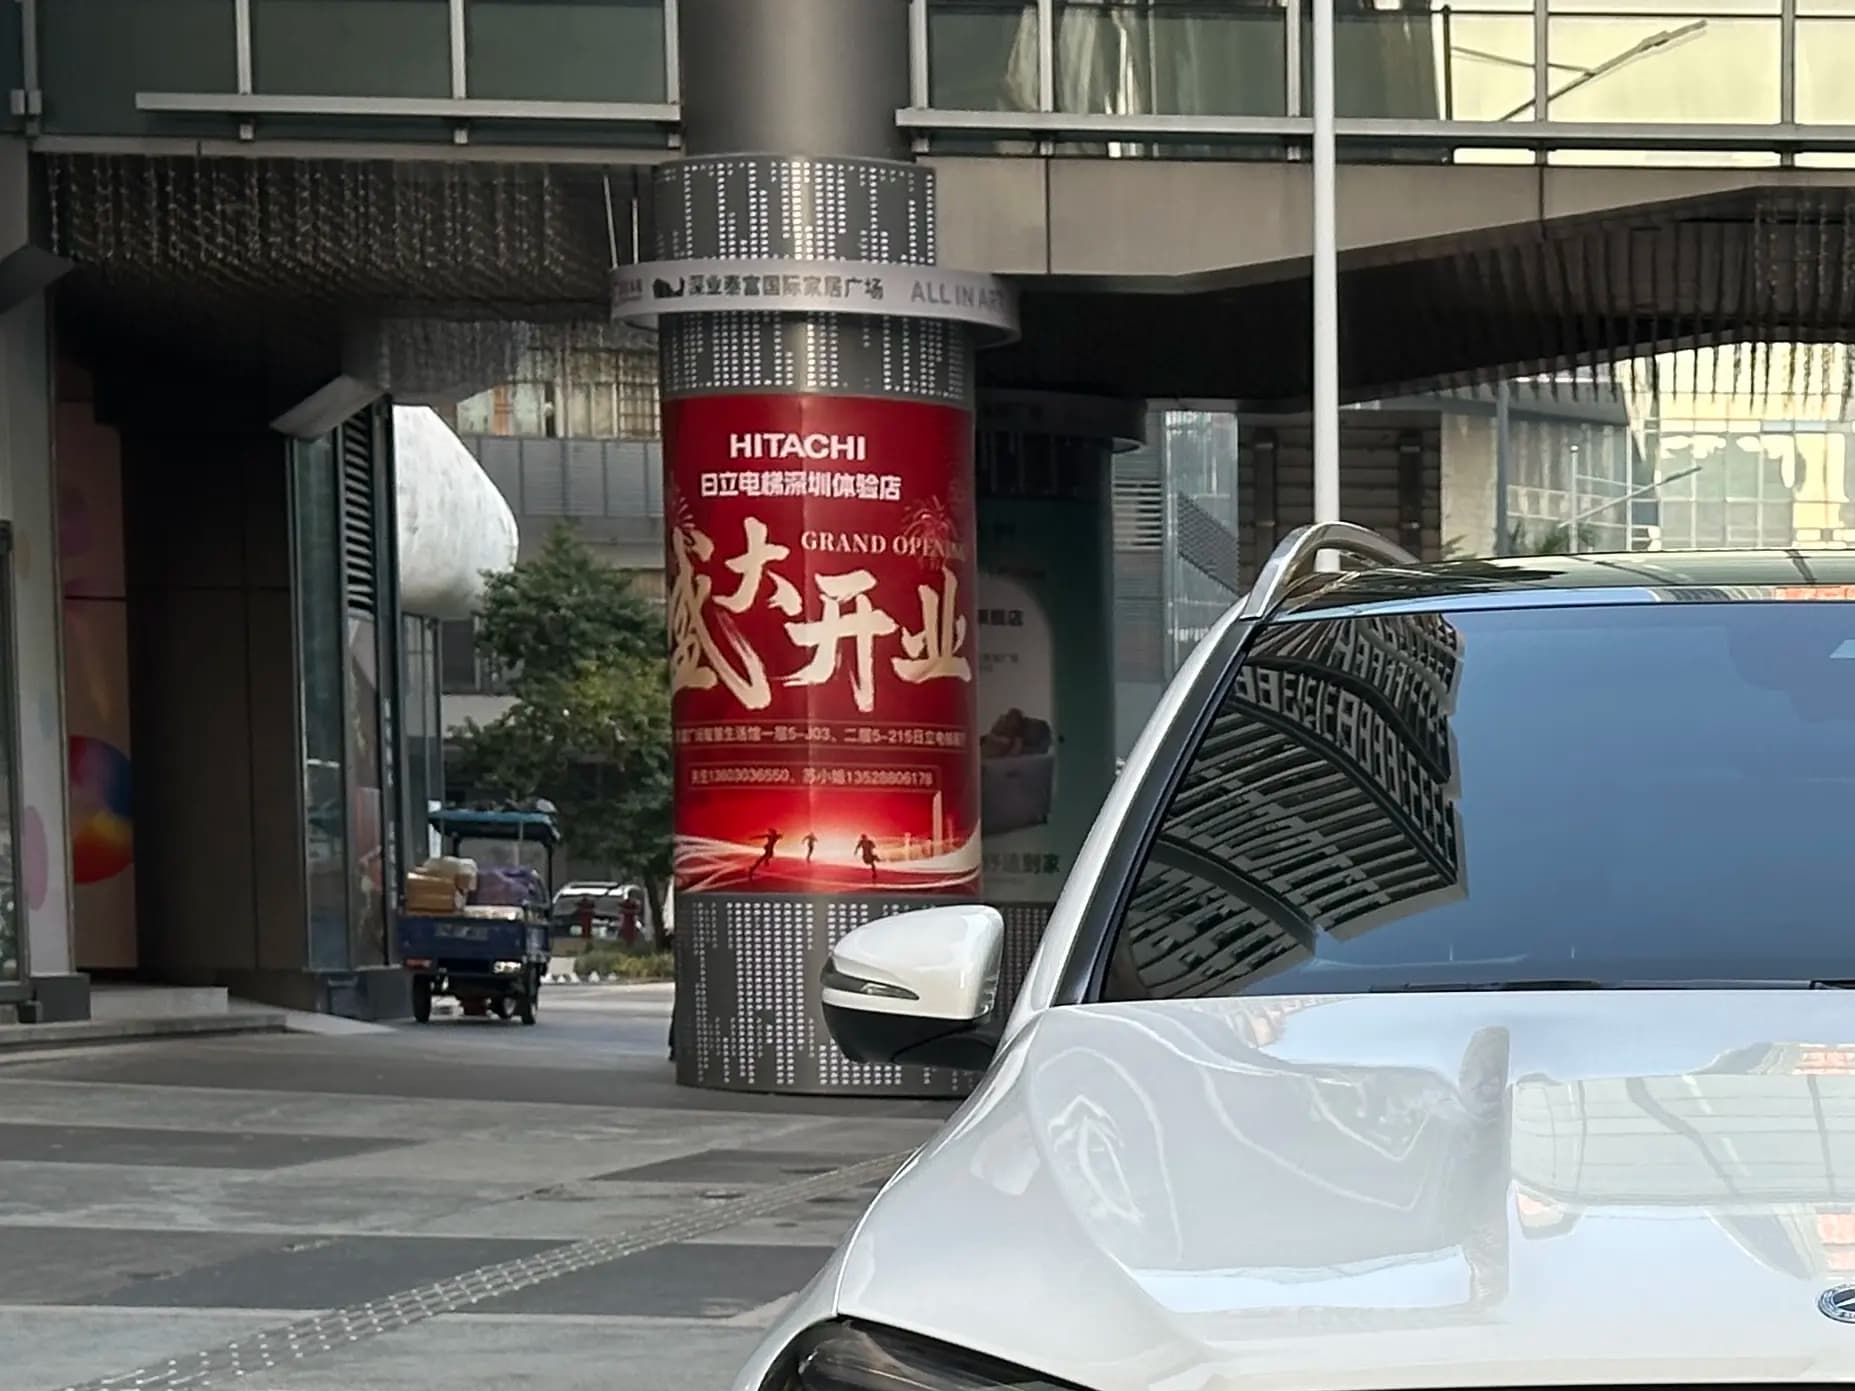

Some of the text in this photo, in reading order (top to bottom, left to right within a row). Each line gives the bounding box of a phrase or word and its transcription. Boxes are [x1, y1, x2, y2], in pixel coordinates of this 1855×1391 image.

[911, 280, 951, 304] ALL
[729, 433, 866, 460] HITACHI
[700, 472, 901, 500] 日立电梯深圳体验店
[801, 531, 886, 553] GRAND
[671, 517, 971, 712] 盛大开业
